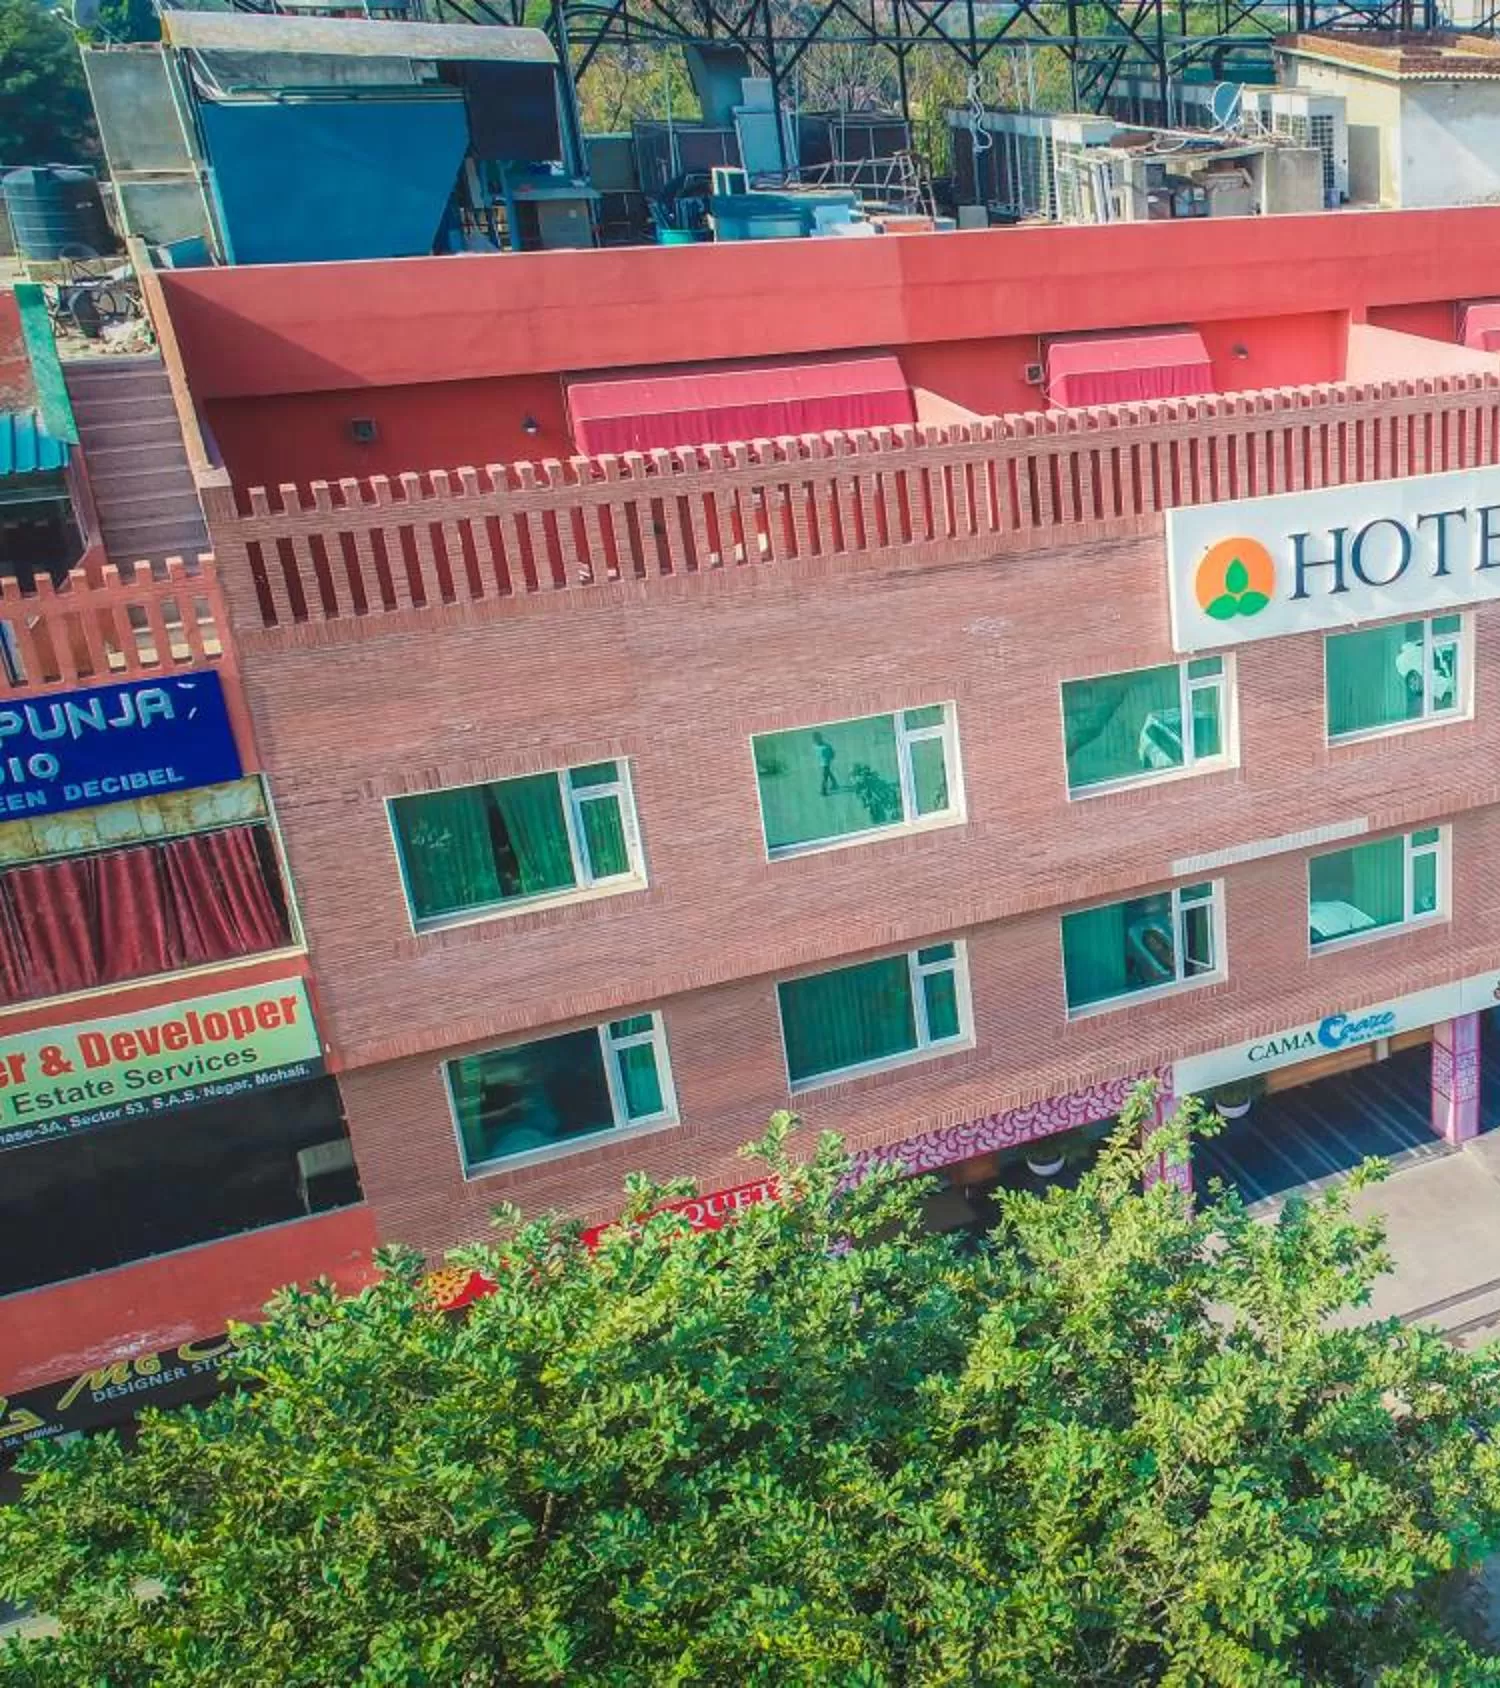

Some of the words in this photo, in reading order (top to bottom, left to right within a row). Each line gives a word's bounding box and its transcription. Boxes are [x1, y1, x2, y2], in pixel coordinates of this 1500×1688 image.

[0, 753, 60, 784] IO
[63, 767, 185, 801] DECIBEL
[39, 1046, 75, 1077] &
[77, 995, 297, 1069] Developer
[1247, 1029, 1317, 1063] CAMA
[11, 1077, 115, 1115] Estate
[124, 1048, 259, 1089] Services
[68, 1107, 122, 1128] Sector
[92, 1367, 188, 1404] DESIGNER
